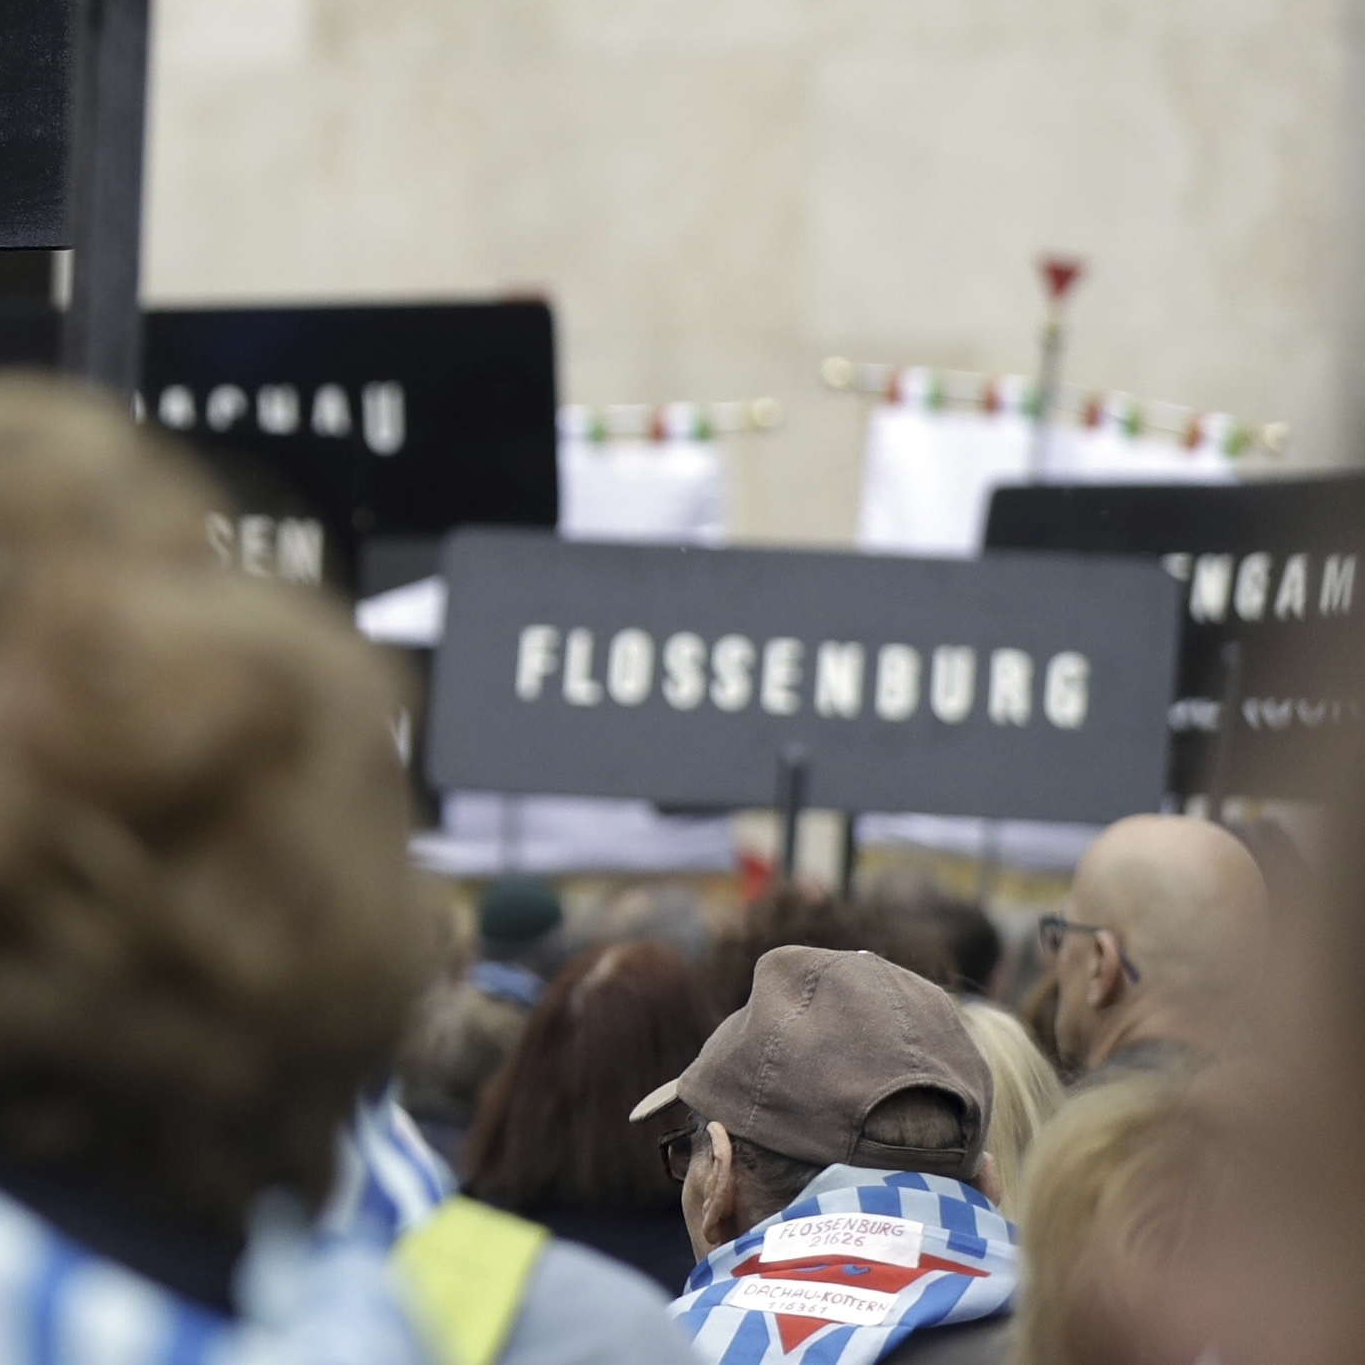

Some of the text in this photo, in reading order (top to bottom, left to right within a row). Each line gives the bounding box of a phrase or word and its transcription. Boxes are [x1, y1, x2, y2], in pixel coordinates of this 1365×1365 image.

[515, 624, 1090, 729] FLOSSENBURG
[779, 1217, 906, 1240] FLOSSENBURG
[808, 1232, 867, 1248] 21626
